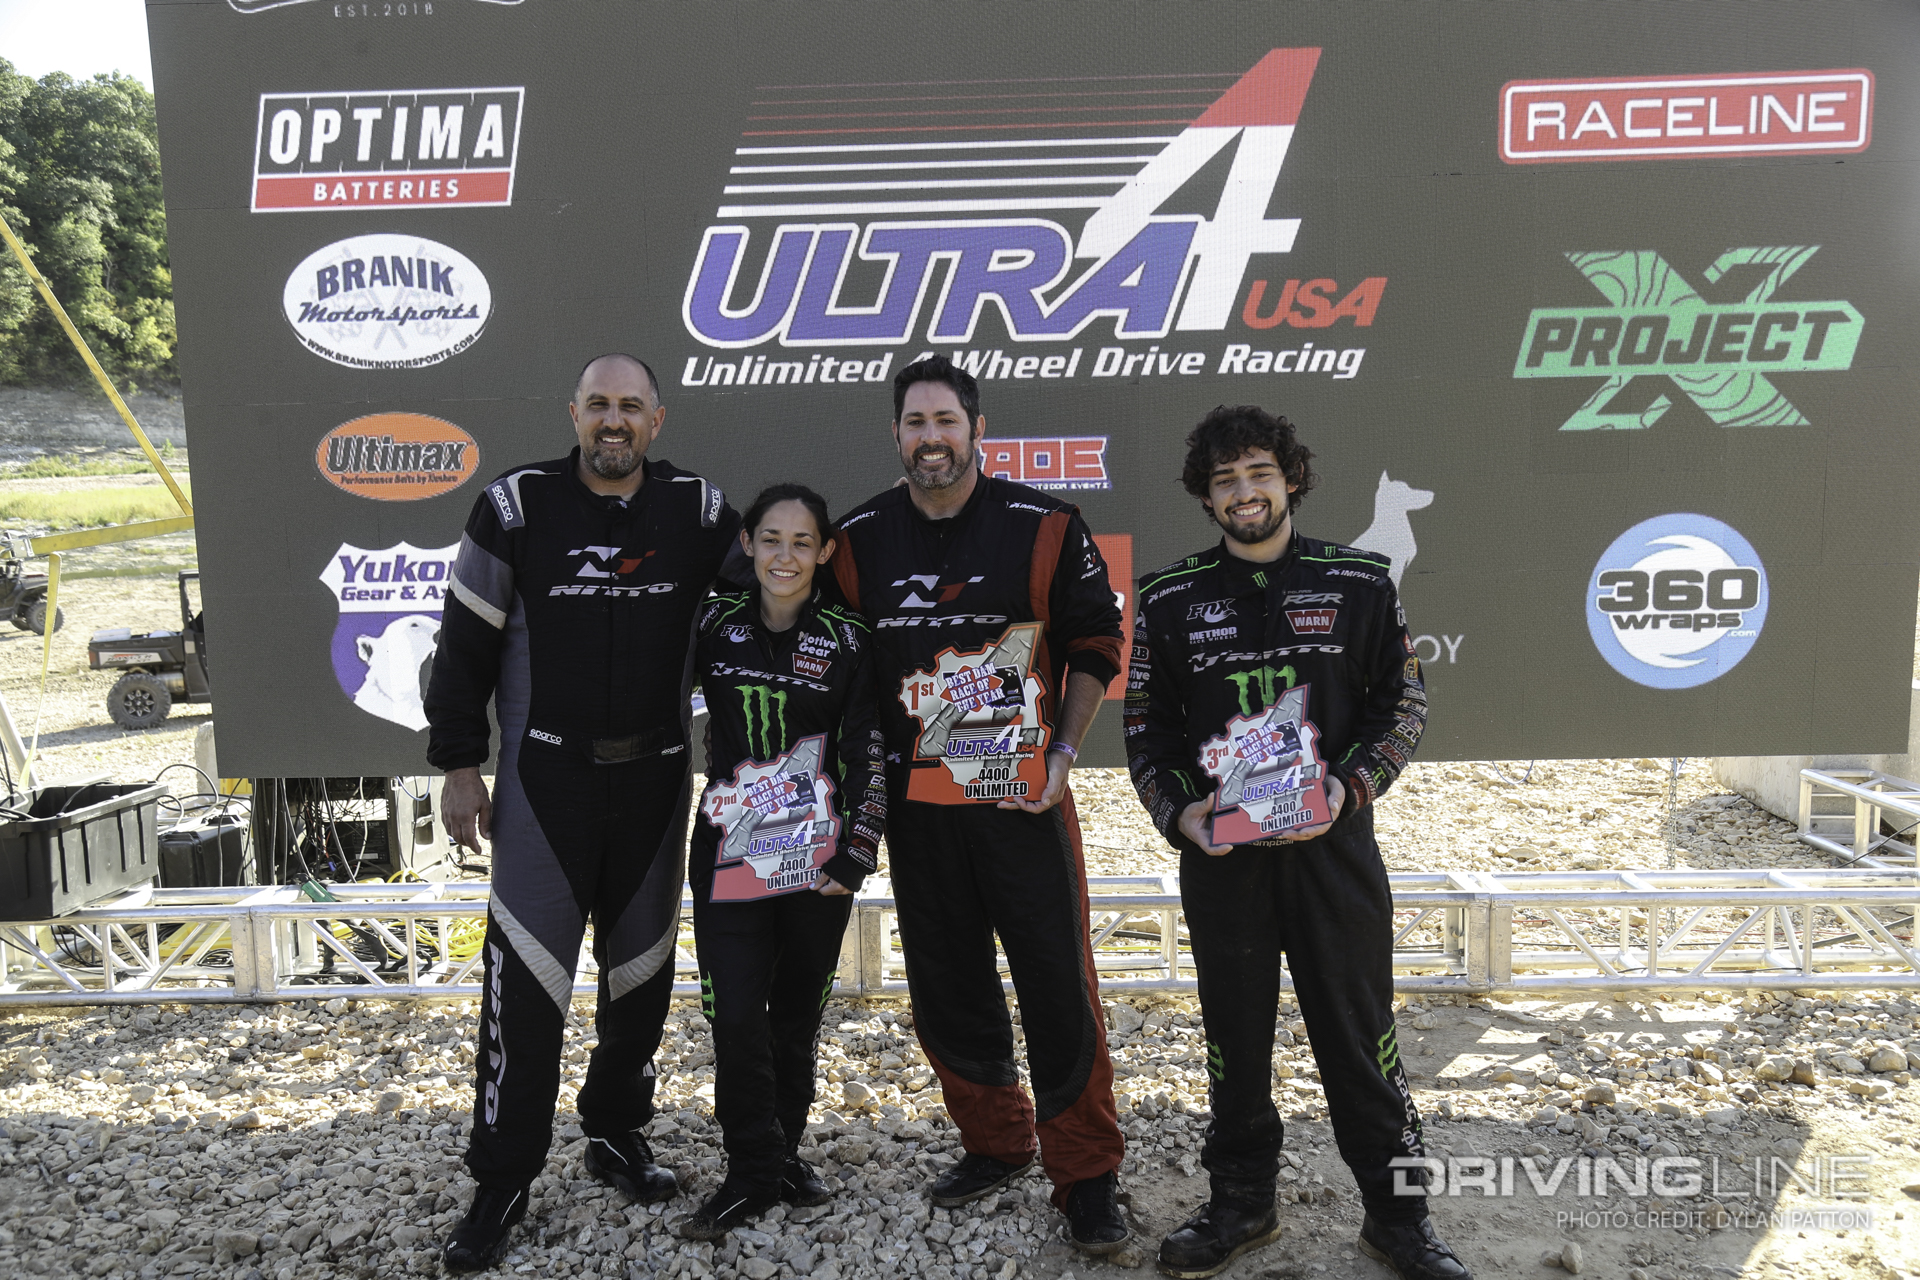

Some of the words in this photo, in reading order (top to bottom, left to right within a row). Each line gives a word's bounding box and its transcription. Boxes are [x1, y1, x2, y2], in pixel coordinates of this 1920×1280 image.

[1527, 92, 1847, 141] RACELINE
[269, 104, 504, 164] OPTIMA
[313, 178, 460, 202] BATTERIES
[316, 255, 454, 301] BRANIK
[297, 302, 480, 326] Motorsports
[1242, 277, 1388, 329] USA
[1525, 309, 1852, 368] PROJECT
[681, 352, 894, 387] Unlimited
[952, 347, 1084, 380] Wheel
[1091, 346, 1206, 378] Drive
[1217, 342, 1366, 380] Racing
[326, 434, 467, 474] Ultimax
[492, 484, 514, 523] sparco
[707, 488, 722, 524] sparco
[1340, 570, 1379, 582] IMPACT
[341, 586, 396, 601] Gear
[400, 585, 417, 600] &
[548, 583, 675, 597] NITTO
[1159, 581, 1194, 598] IMPACT
[1282, 593, 1344, 607] RZR
[1597, 568, 1760, 612] 360
[876, 614, 1008, 629] NITTO
[1186, 598, 1238, 623] FOX
[1294, 616, 1330, 627] WARN
[720, 625, 754, 643] FOX
[1189, 626, 1238, 641] METHOD
[1612, 613, 1742, 633] wraps
[1727, 629, 1757, 638] .com
[798, 631, 838, 650] Motive
[799, 642, 831, 658] Gear
[1225, 644, 1345, 662] NITTO
[796, 659, 823, 673] WARN
[945, 668, 974, 688] BEST
[972, 661, 997, 679] DAM
[737, 668, 830, 692] NITTO
[949, 684, 978, 702] RACE
[976, 677, 991, 691] OF
[908, 681, 935, 711] 1st
[955, 698, 978, 713] THE
[976, 687, 1006, 706] YEAR
[529, 728, 563, 746] sparco
[1236, 731, 1259, 749] BEST
[1257, 721, 1278, 737] DAM
[1241, 741, 1262, 758] RACE
[1262, 733, 1273, 748] OF
[1017, 743, 1036, 753] USA
[1207, 745, 1229, 769] 3rd
[1263, 739, 1287, 757] YEAR
[745, 780, 770, 797] BEST
[769, 770, 792, 787] DAM
[978, 767, 1010, 782] 4400
[750, 789, 774, 807] RACE
[774, 783, 786, 797] OF
[964, 781, 1028, 799] UNLIMITED
[711, 792, 737, 817] 2nd
[754, 800, 776, 817] THE
[773, 790, 800, 810] YEAR
[1270, 800, 1297, 817] 4400
[1260, 809, 1313, 834] UNLIMITED
[811, 835, 828, 844] USA
[778, 857, 806, 874] 4400
[766, 867, 823, 890] UNLIMITED
[485, 941, 507, 1126] NITTO
